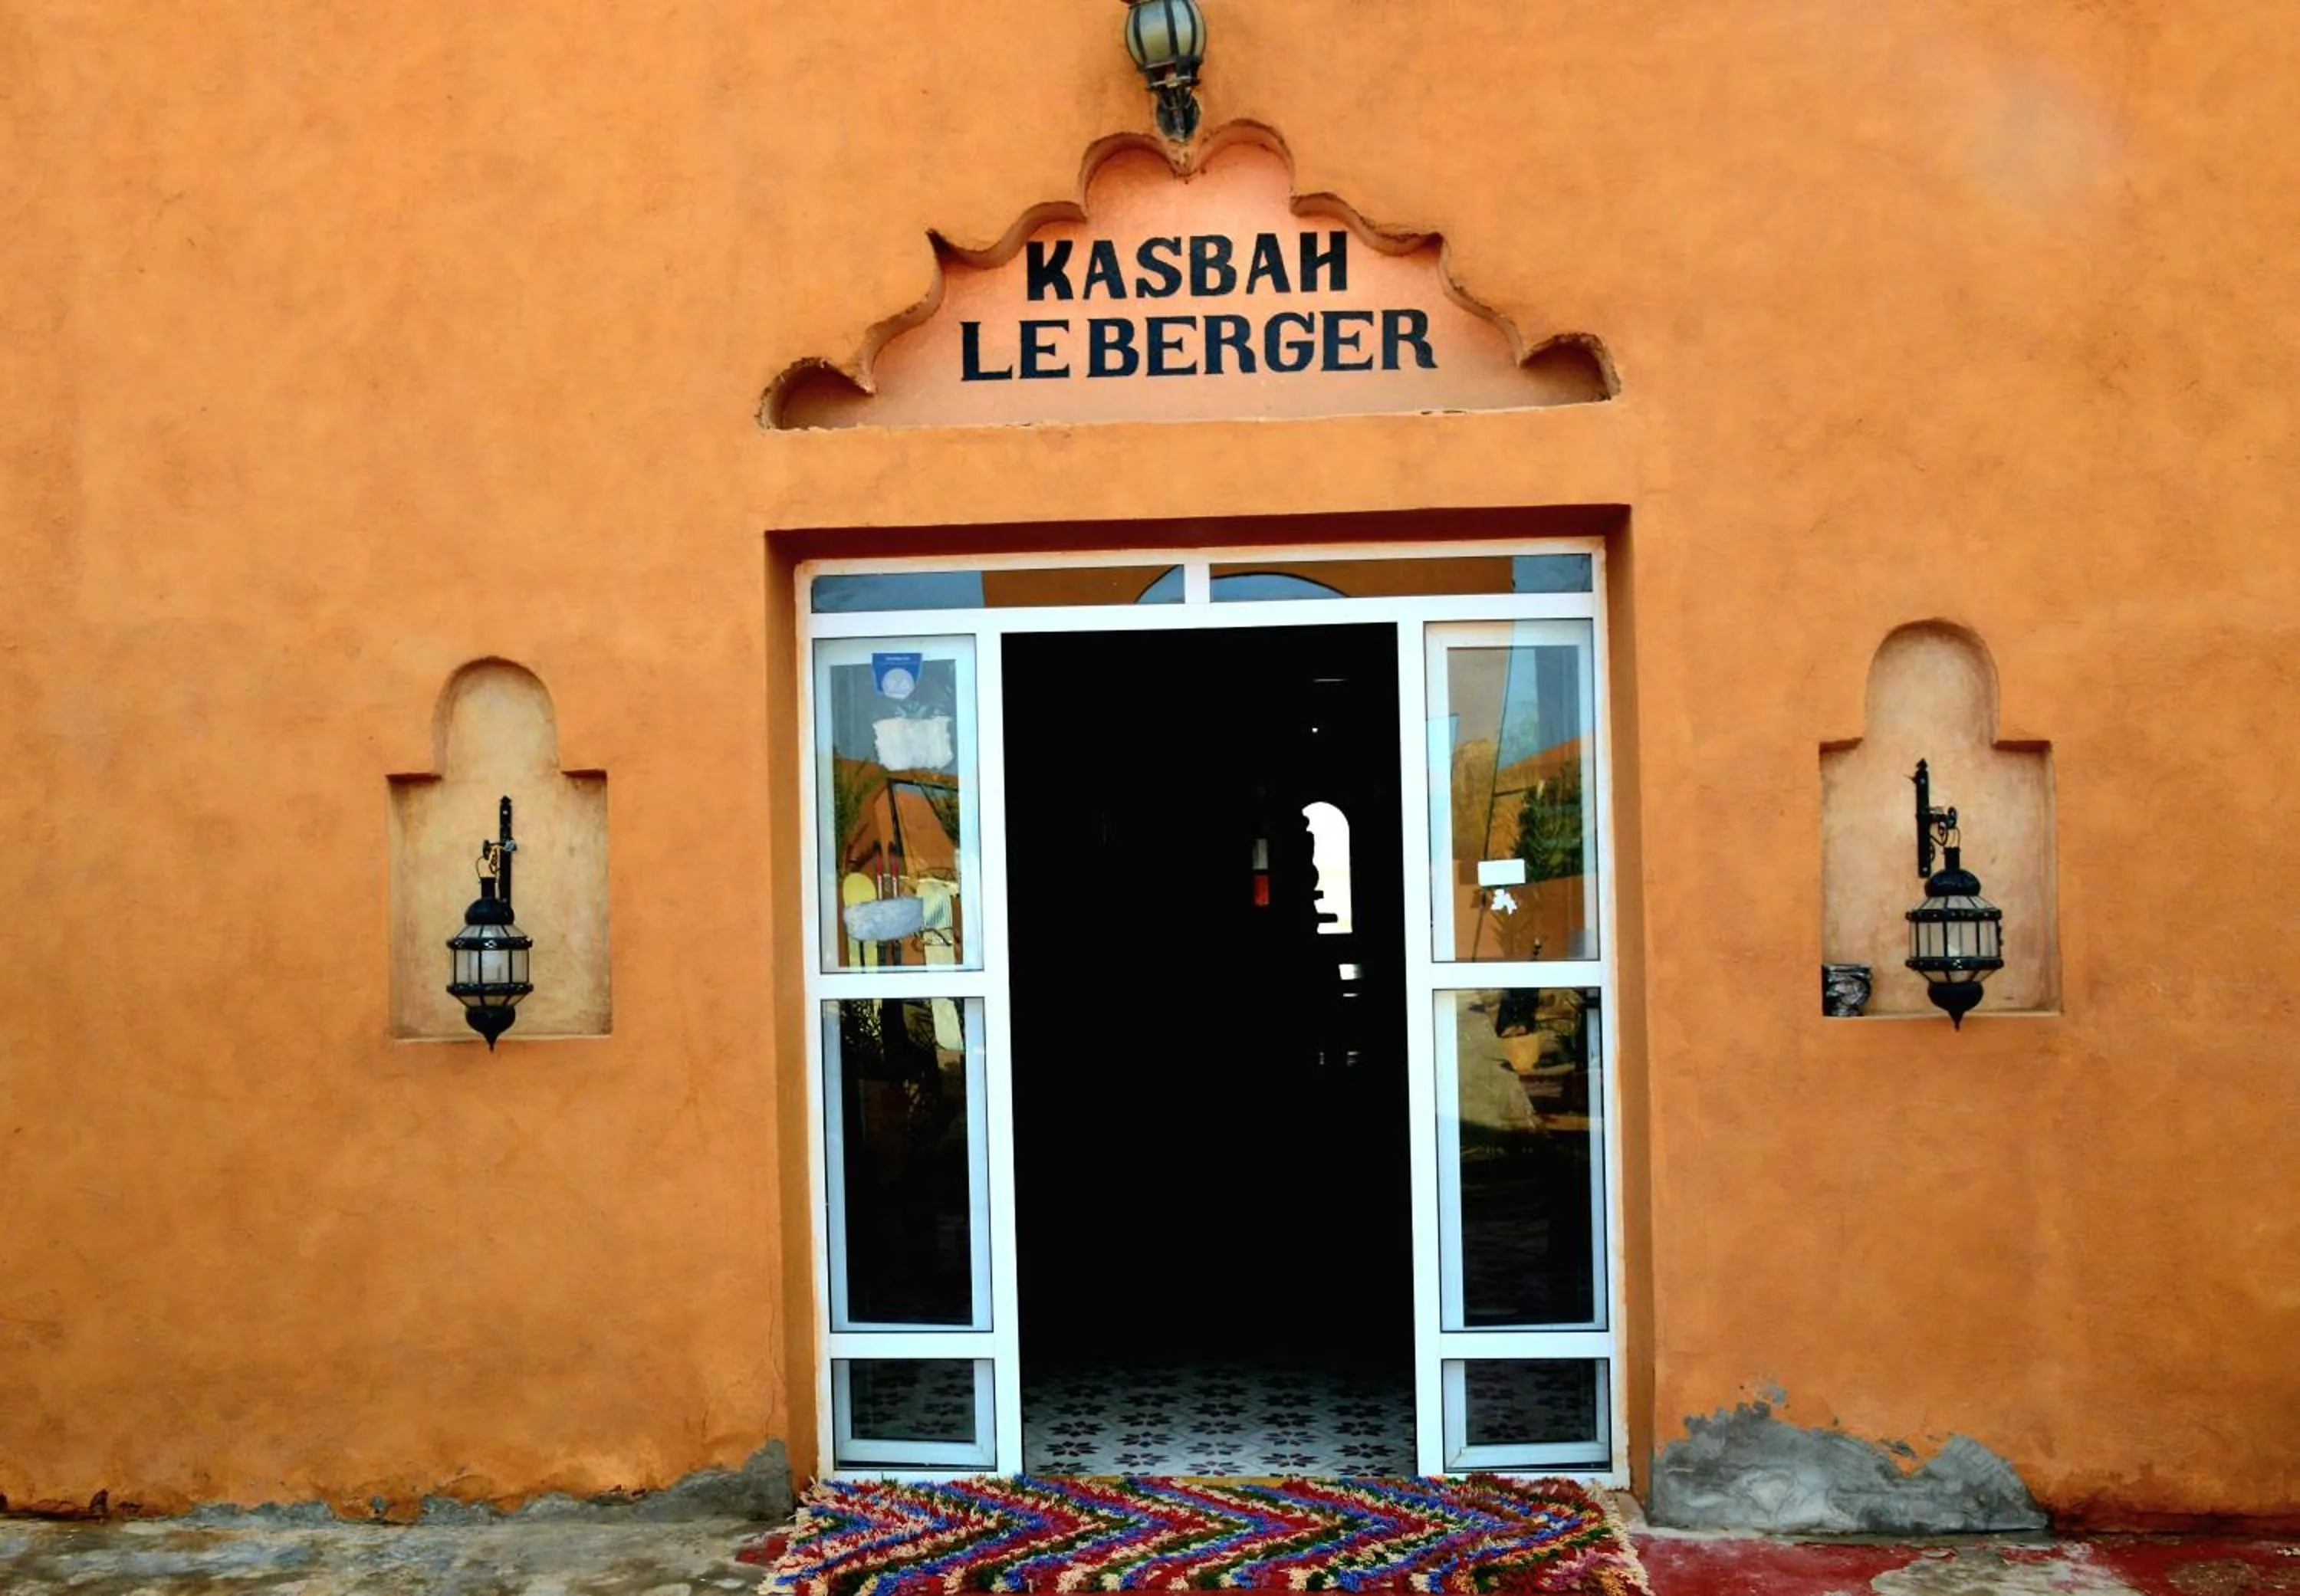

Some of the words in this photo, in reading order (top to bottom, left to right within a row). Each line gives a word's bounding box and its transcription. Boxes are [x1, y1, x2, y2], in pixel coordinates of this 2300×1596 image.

[1025, 230, 1348, 301] KASBAH
[959, 319, 1070, 382] LE
[1086, 308, 1438, 378] BERGER
